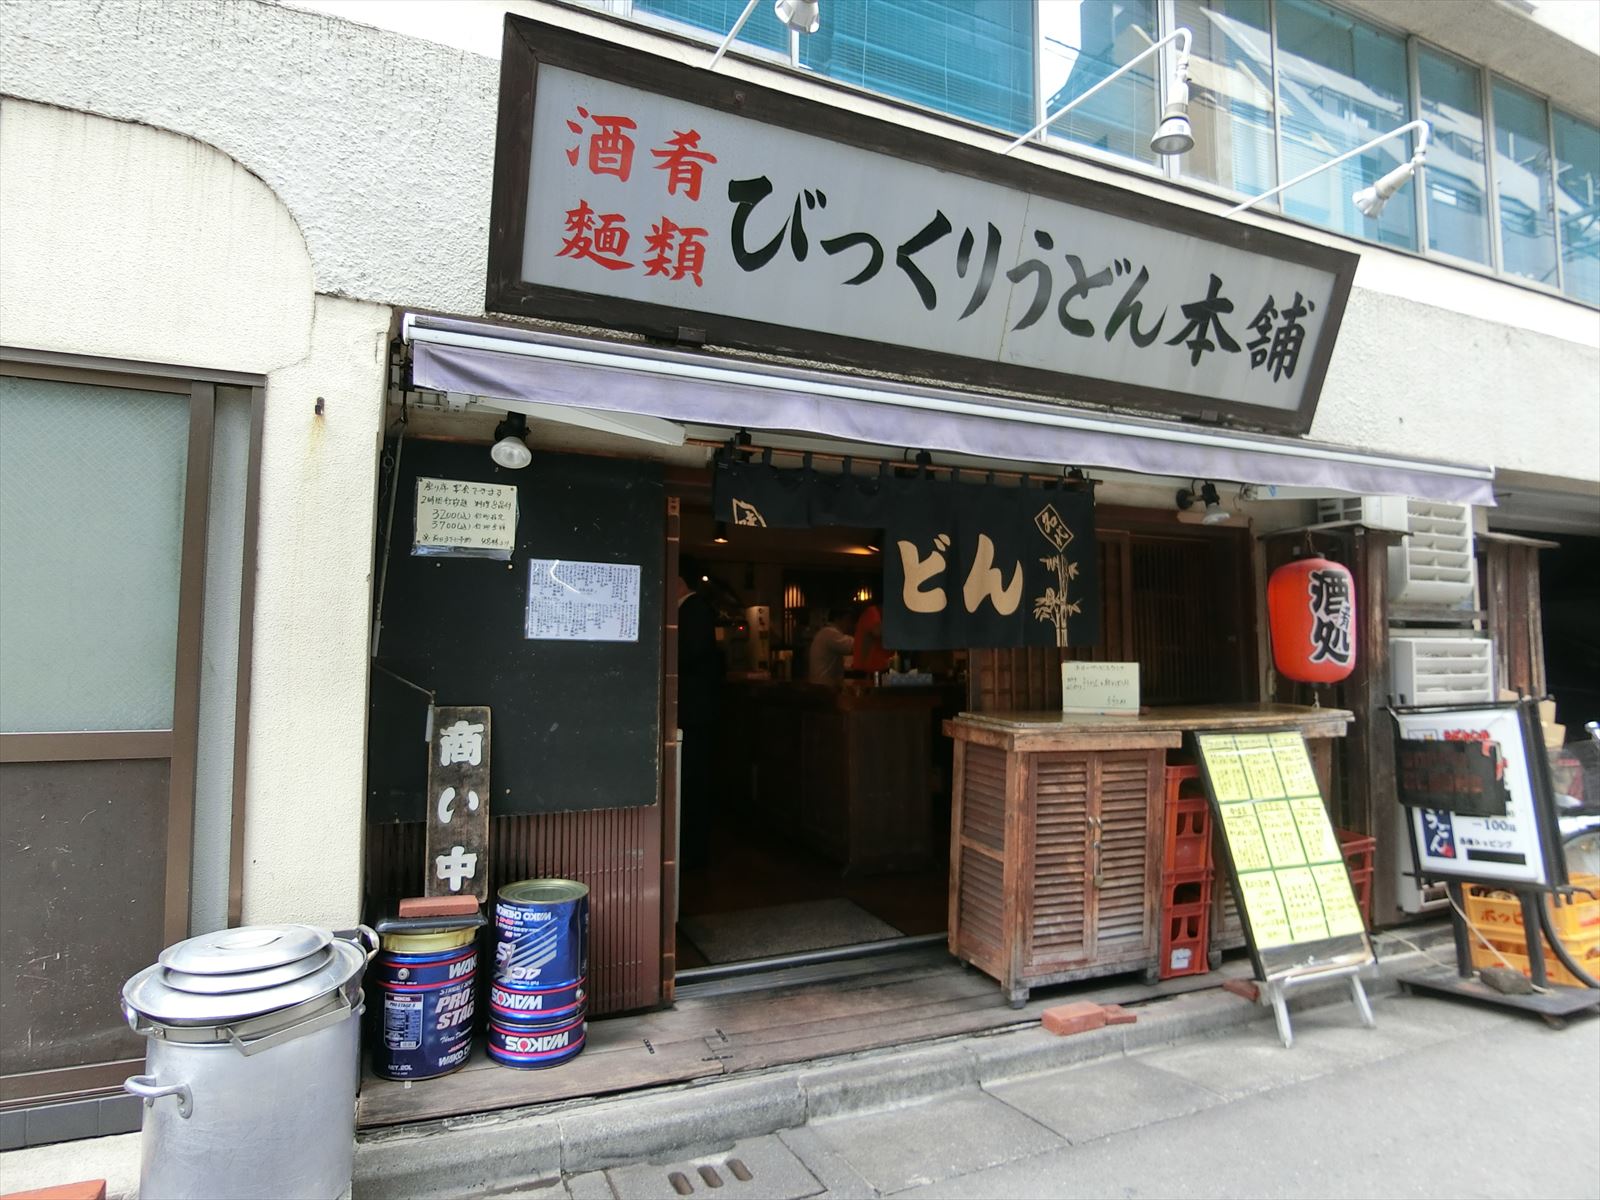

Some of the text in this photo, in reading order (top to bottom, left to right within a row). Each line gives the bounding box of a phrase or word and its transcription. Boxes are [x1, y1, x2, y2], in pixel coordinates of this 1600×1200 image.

[565, 105, 717, 201] 酒肴
[728, 175, 1315, 383] びっくりうどん本舗
[897, 532, 1024, 616] どん
[1309, 570, 1350, 663] 酒処
[436, 720, 484, 892] 商い中
